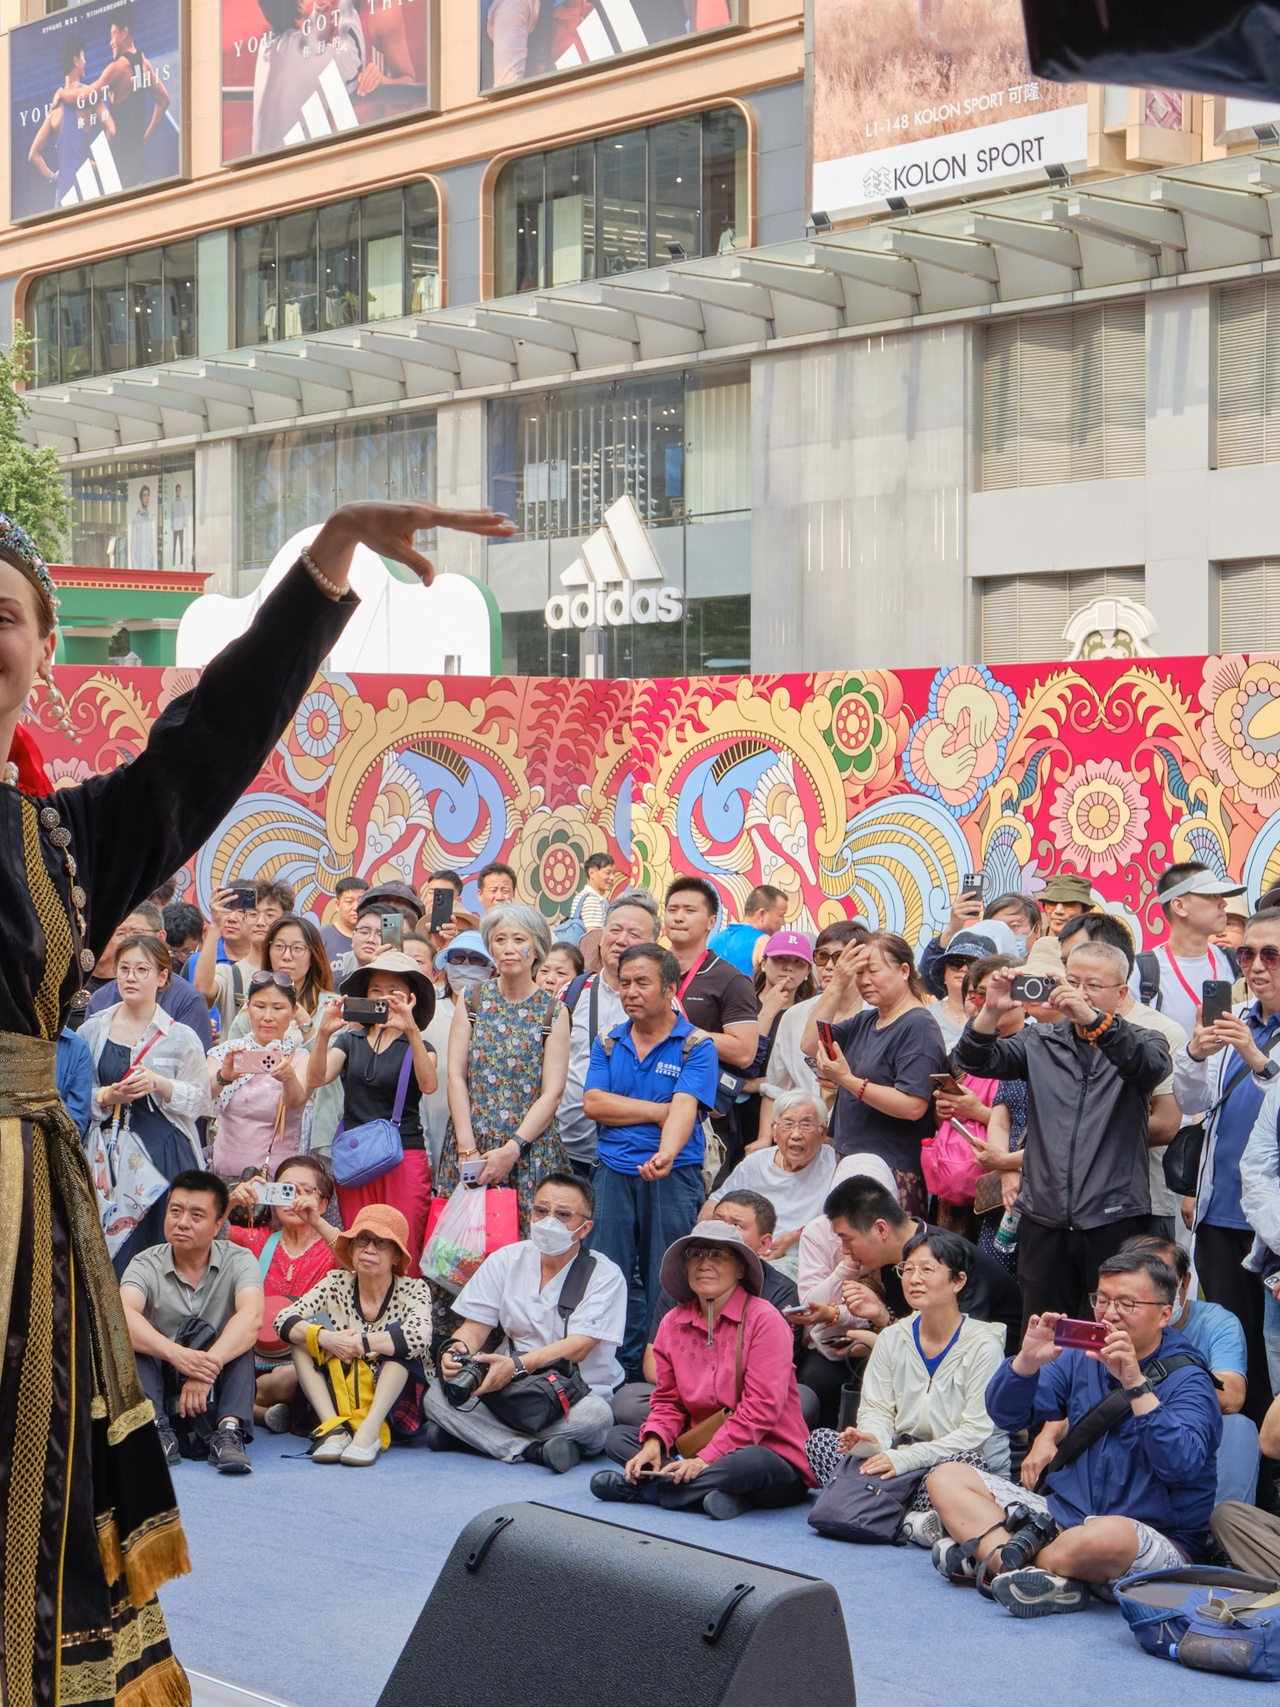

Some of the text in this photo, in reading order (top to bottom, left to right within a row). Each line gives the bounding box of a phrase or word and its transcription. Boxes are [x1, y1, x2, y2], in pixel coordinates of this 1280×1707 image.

[367, 0, 414, 15] TH
[233, 9, 340, 57] YOU GOT
[303, 36, 340, 58] 你行的
[20, 65, 170, 127] YOU GOT THIS
[78, 109, 110, 129] 你行的
[866, 82, 1041, 137] L1-148 KOLON SPORT 可隆
[894, 137, 1045, 190] KOLON SPORT
[545, 579, 683, 630] adidas
[788, 935, 798, 945] R
